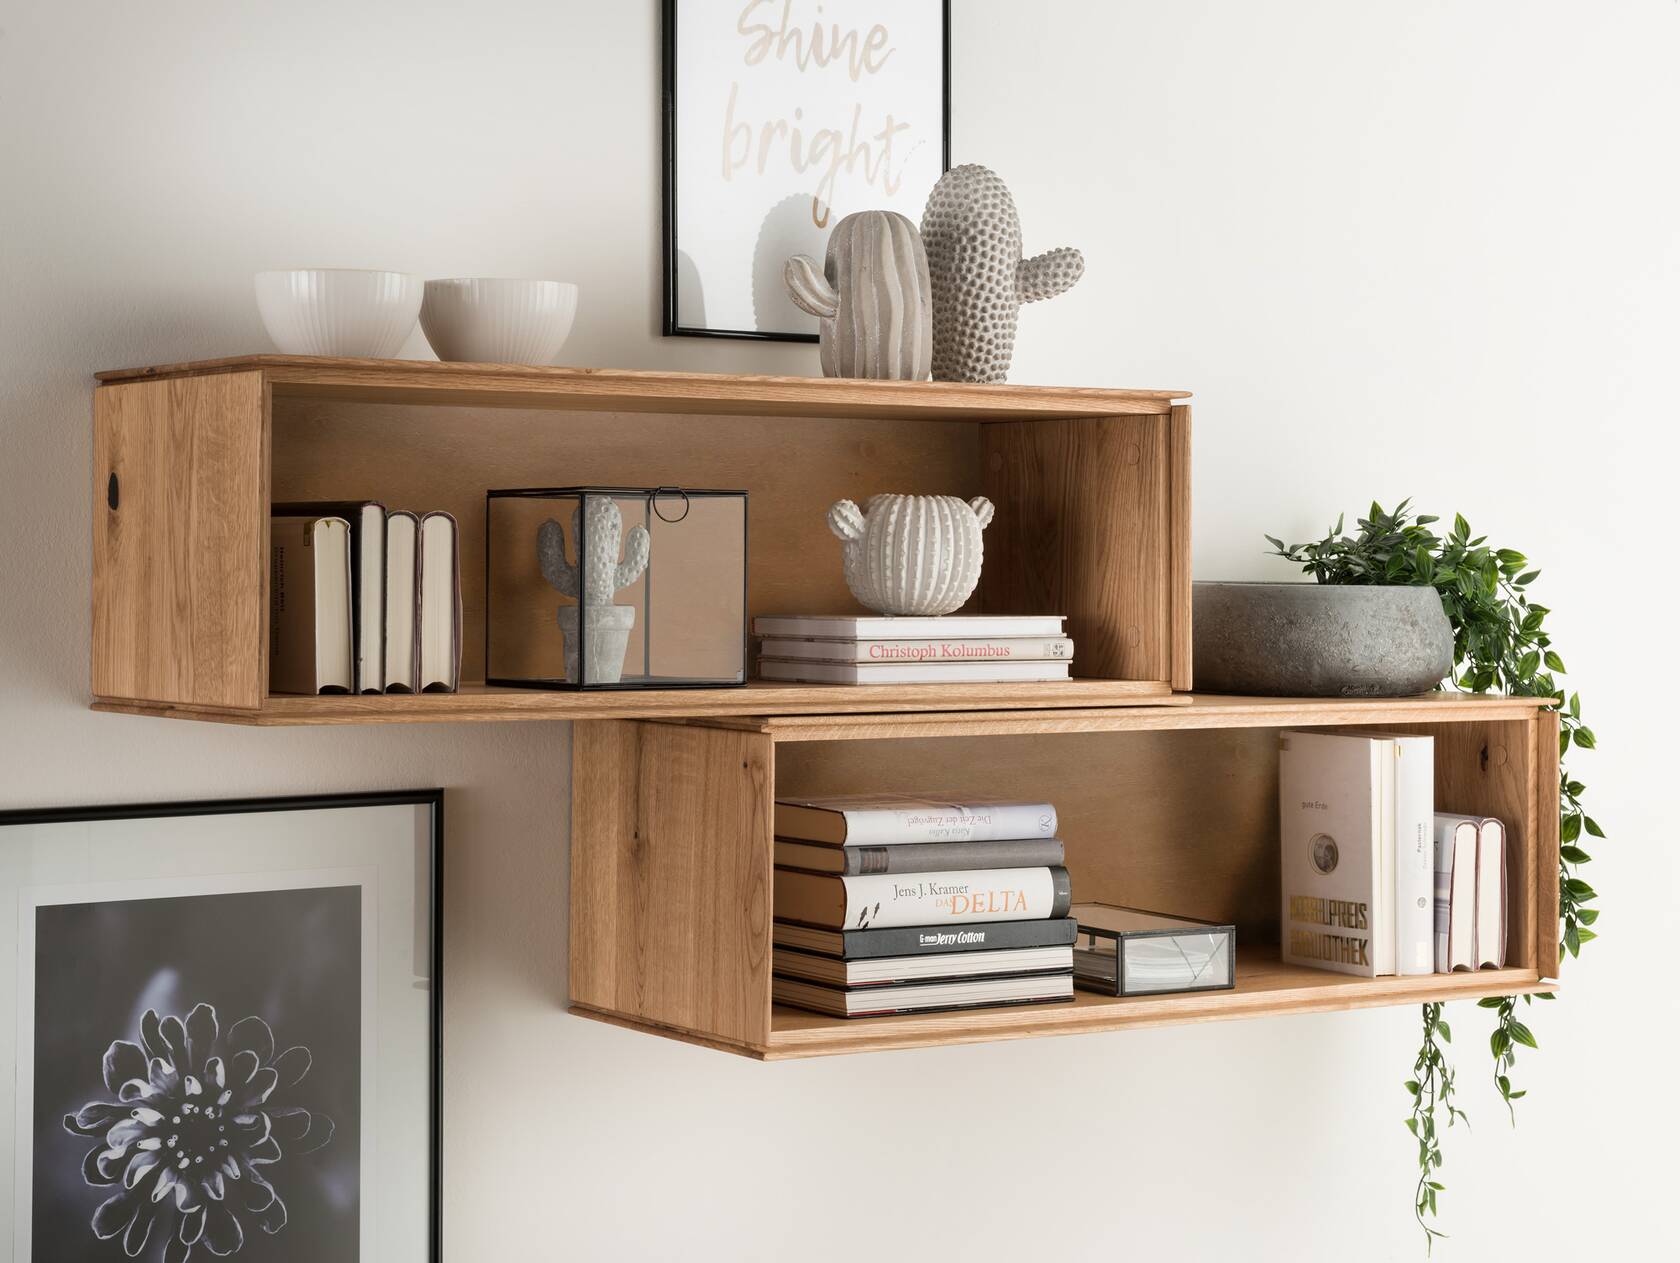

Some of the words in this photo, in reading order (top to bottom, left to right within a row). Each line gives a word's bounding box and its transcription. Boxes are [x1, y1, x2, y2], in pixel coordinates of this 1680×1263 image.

[737, 0, 896, 82] Shine
[722, 81, 922, 229] bright
[869, 644, 937, 661] Christoph
[941, 643, 1010, 658] Kolumbus
[946, 816, 958, 826] der
[959, 815, 976, 825] Zeit
[976, 815, 992, 825] Die
[893, 884, 916, 900] Jens
[918, 883, 927, 899] J.
[929, 882, 969, 896] Kramer
[951, 890, 1027, 915] DELTA
[1290, 895, 1368, 930] ELPREIS
[936, 932, 957, 945] Jerry
[957, 931, 985, 944] Cotton
[1290, 928, 1369, 967] LIOTHEK
